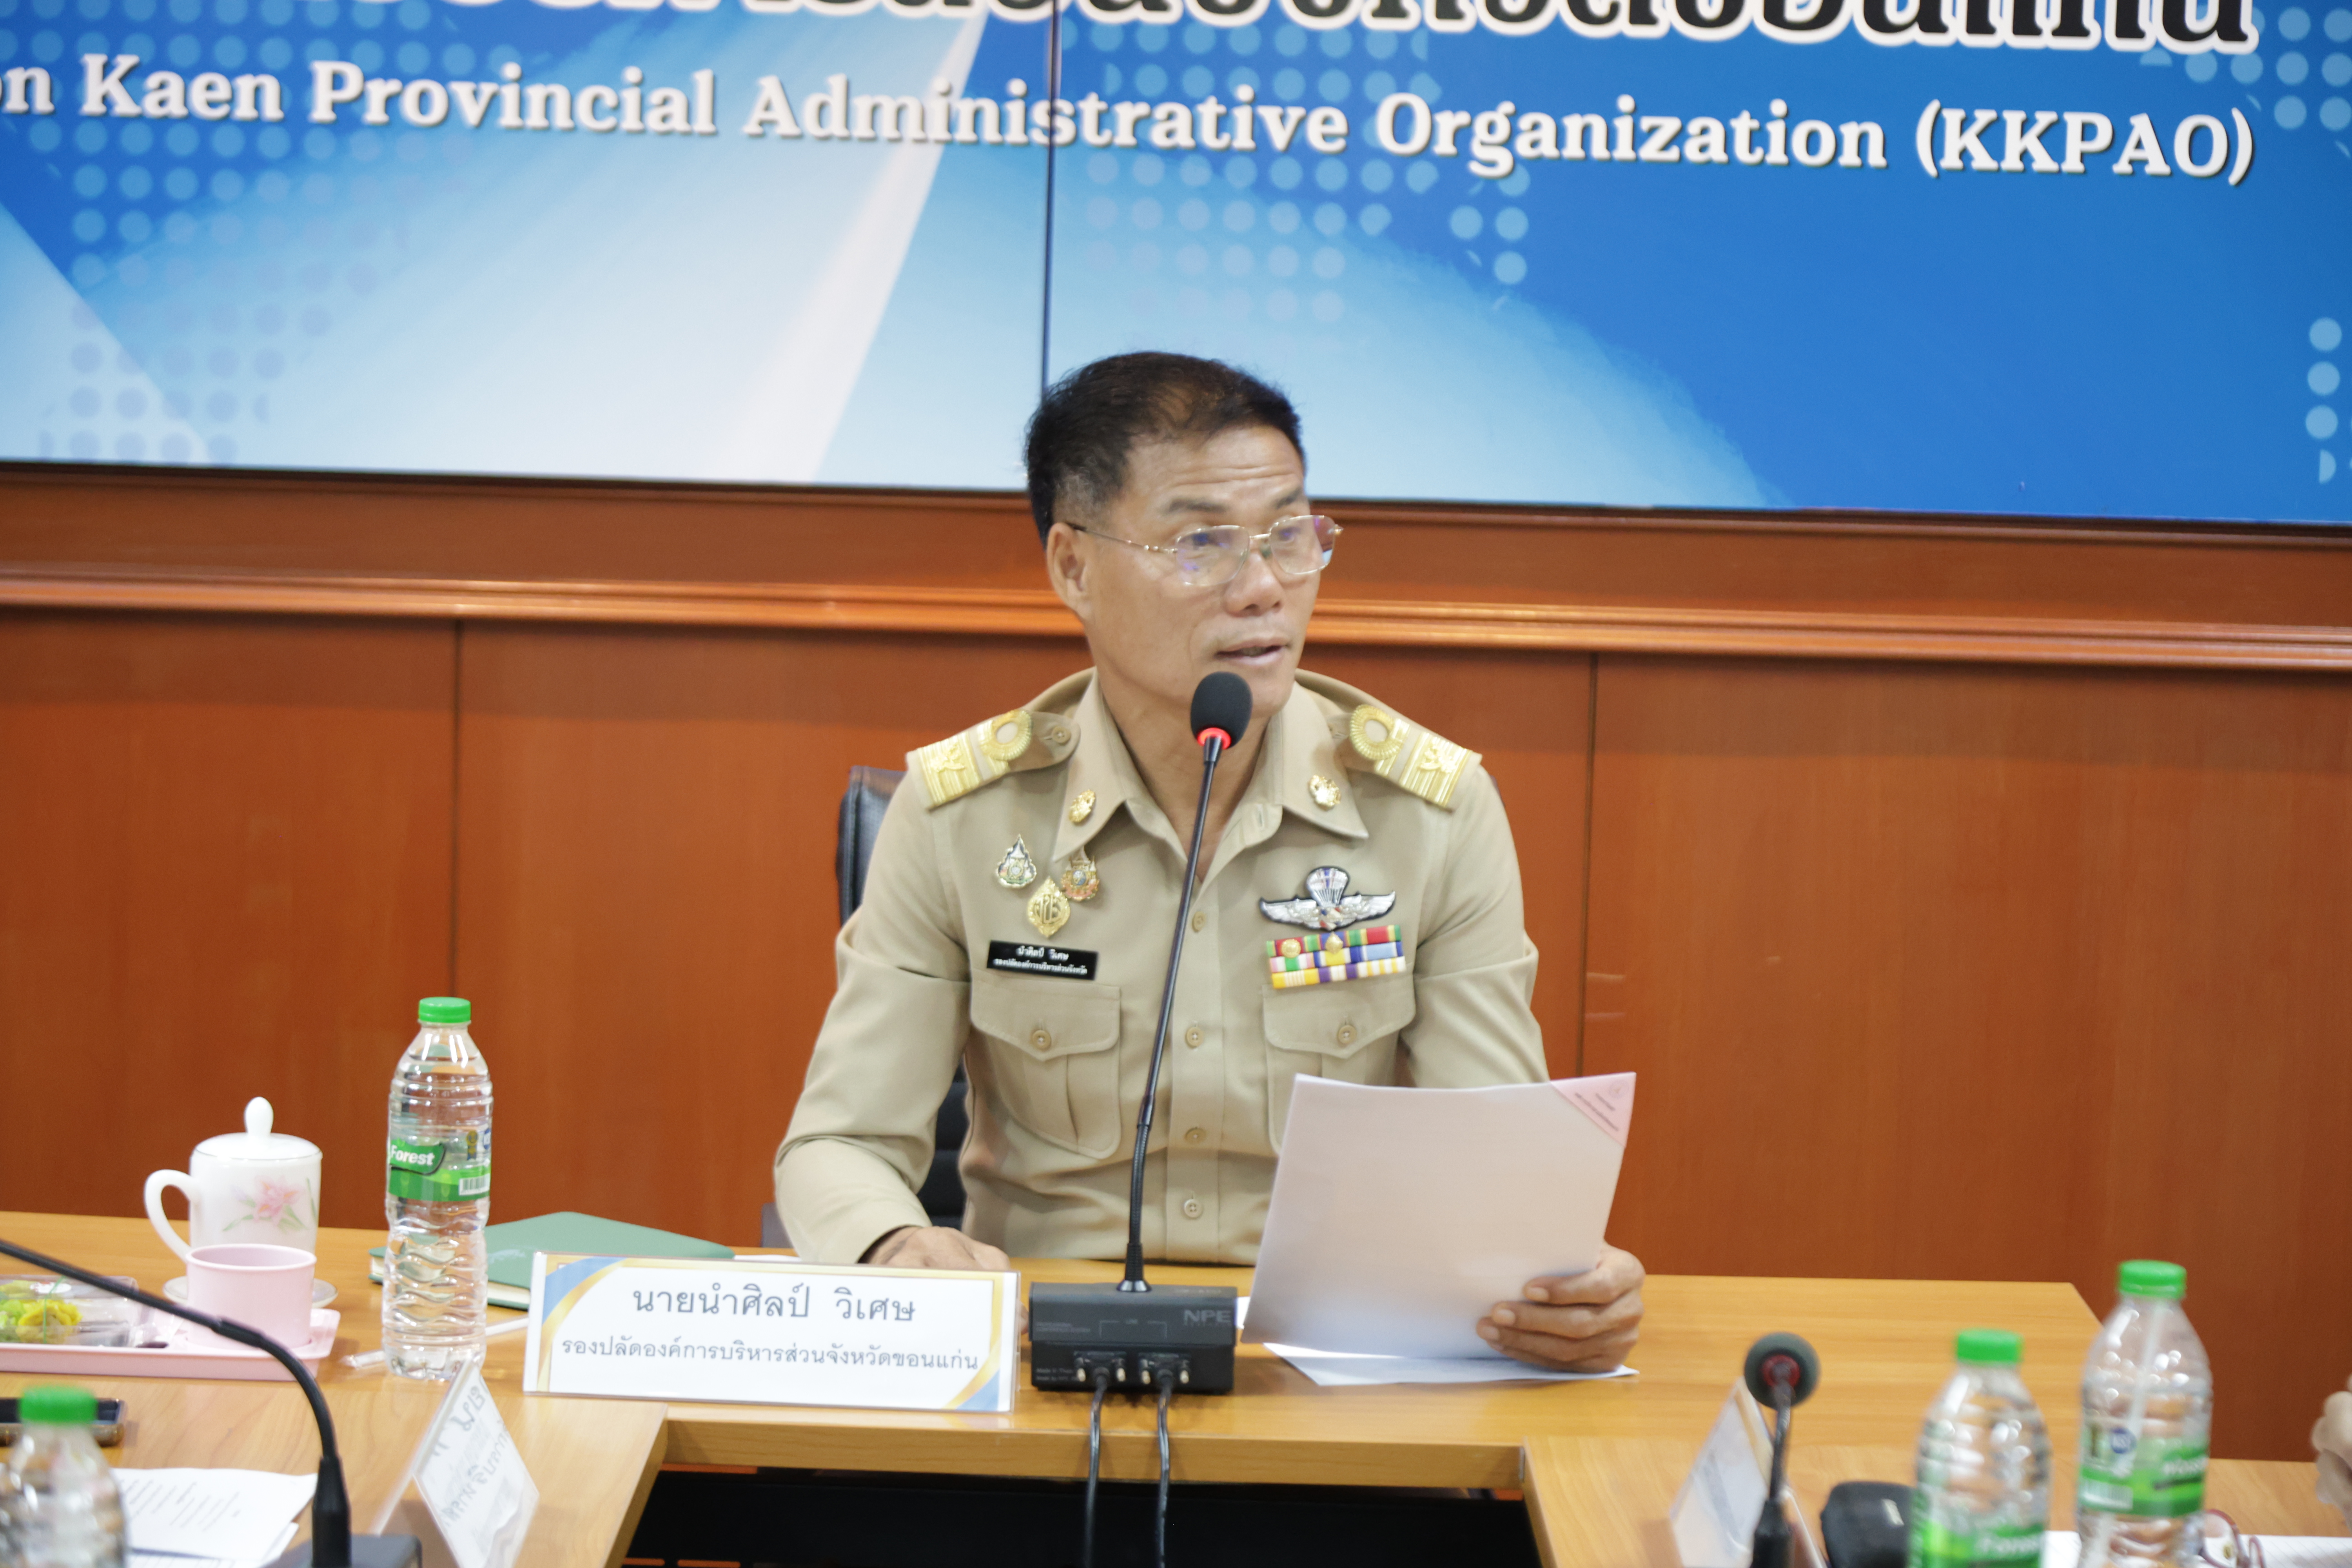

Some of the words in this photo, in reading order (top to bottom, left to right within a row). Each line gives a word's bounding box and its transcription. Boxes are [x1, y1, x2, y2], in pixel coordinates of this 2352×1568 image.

[0, 65, 53, 115] n
[79, 53, 285, 123] Kaen
[308, 59, 718, 135] Provincial
[740, 71, 1348, 155] Administrative
[1376, 92, 1888, 179] Organization
[1915, 98, 2254, 186] (KKPAO)
[632, 1281, 811, 1318] นายนำศิลป์
[833, 1286, 916, 1321] วิเศษ
[1184, 1309, 1232, 1324] NPE
[562, 1335, 978, 1370] รองปลัดองค์การบริหารส่วนจังหวัดขอนแก่น
